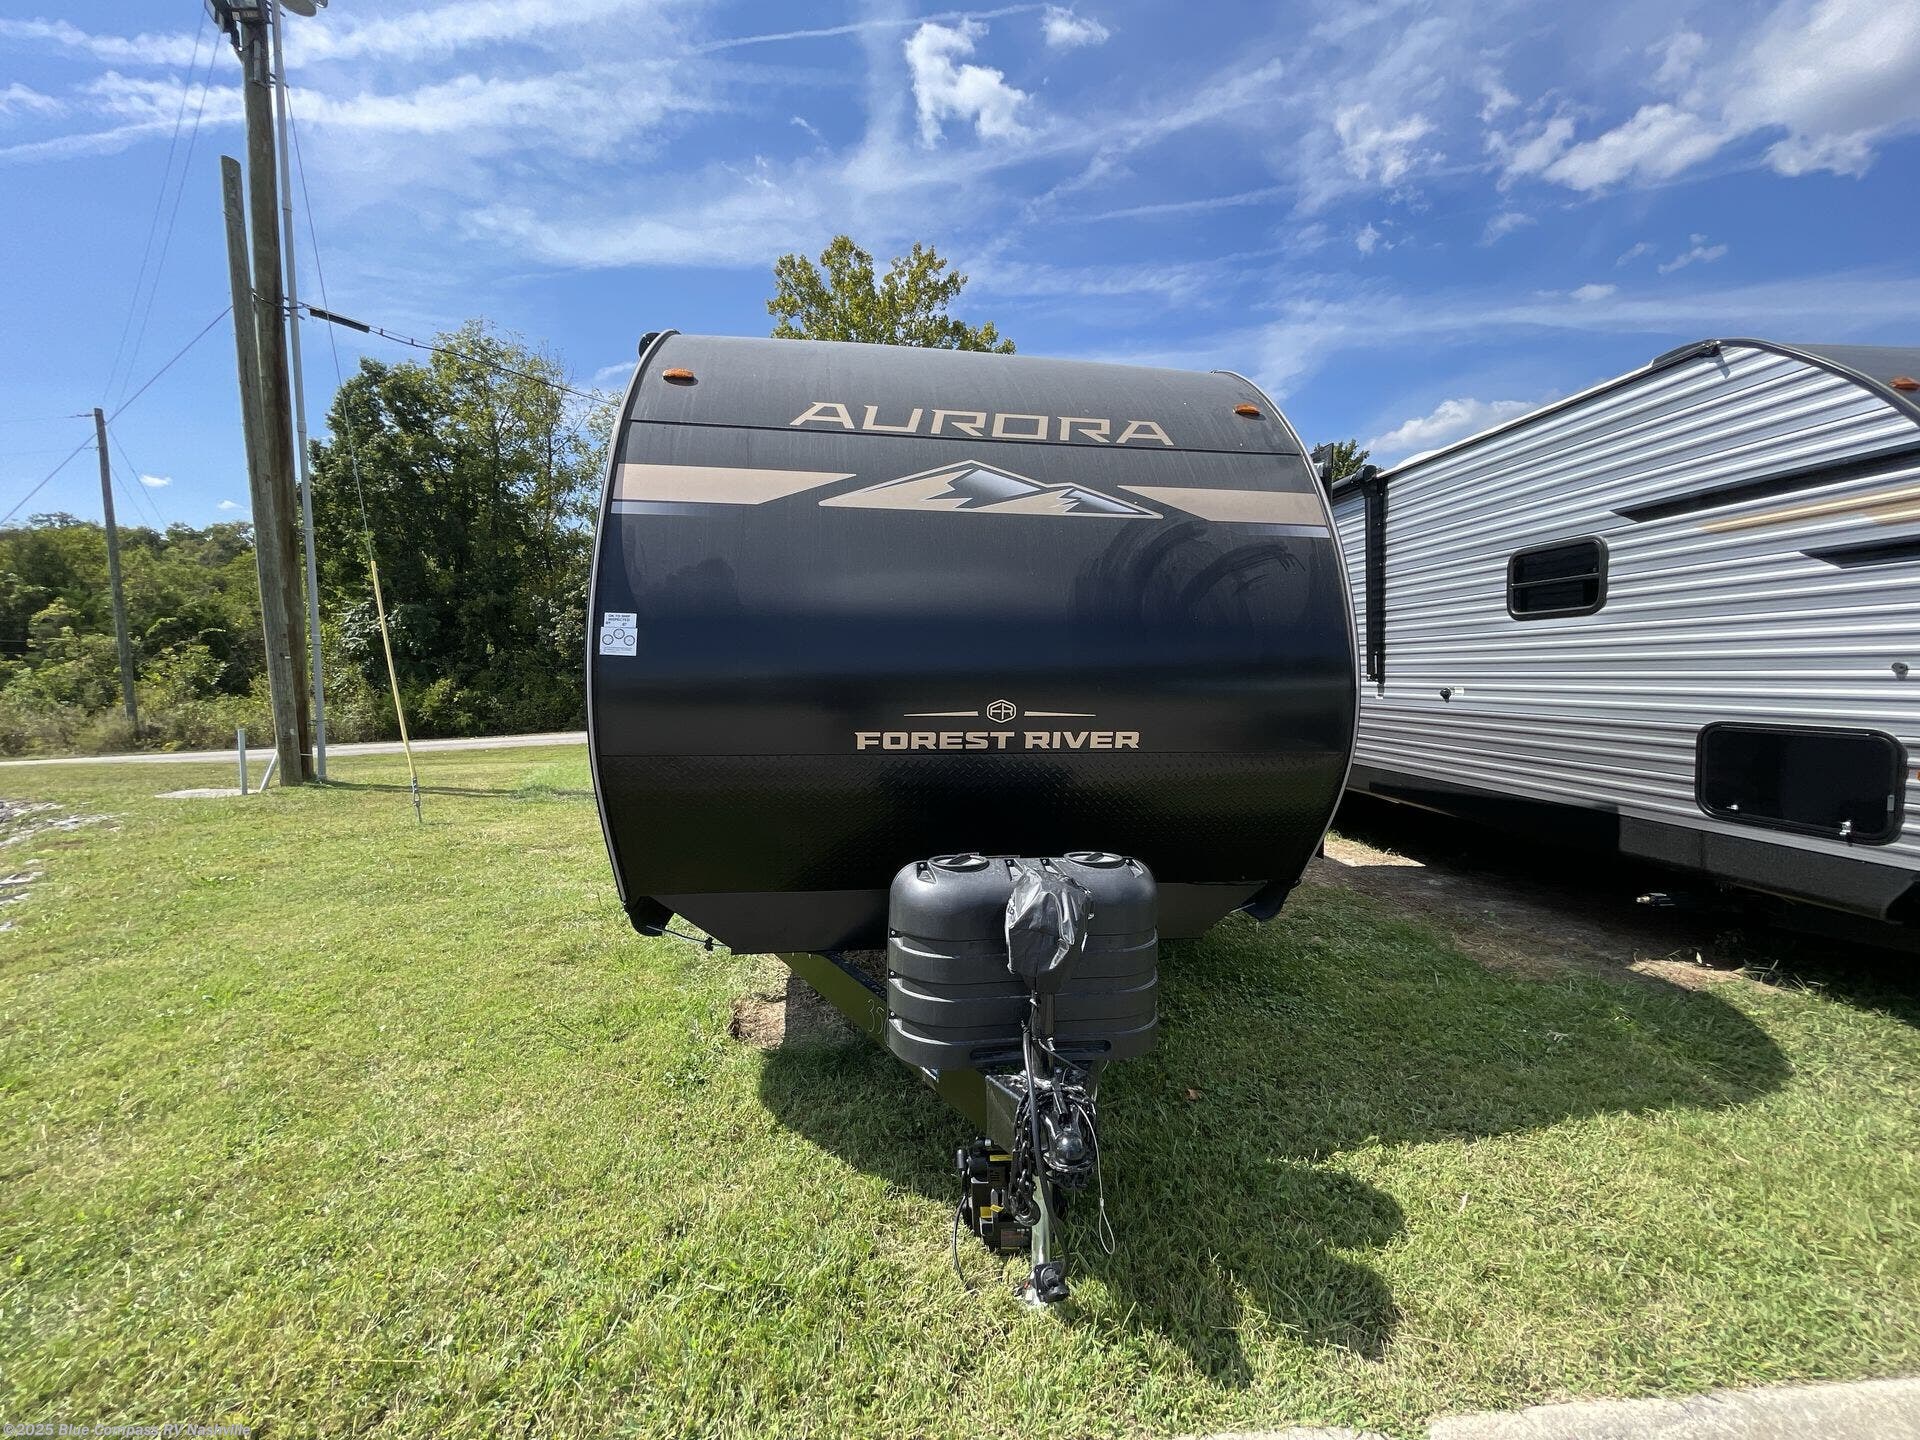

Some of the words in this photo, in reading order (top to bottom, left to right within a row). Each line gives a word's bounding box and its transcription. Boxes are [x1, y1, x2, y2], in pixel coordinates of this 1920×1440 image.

[790, 401, 1174, 447] AURORA
[855, 731, 1015, 750] FOREST
[1023, 731, 1140, 750] RIVER
